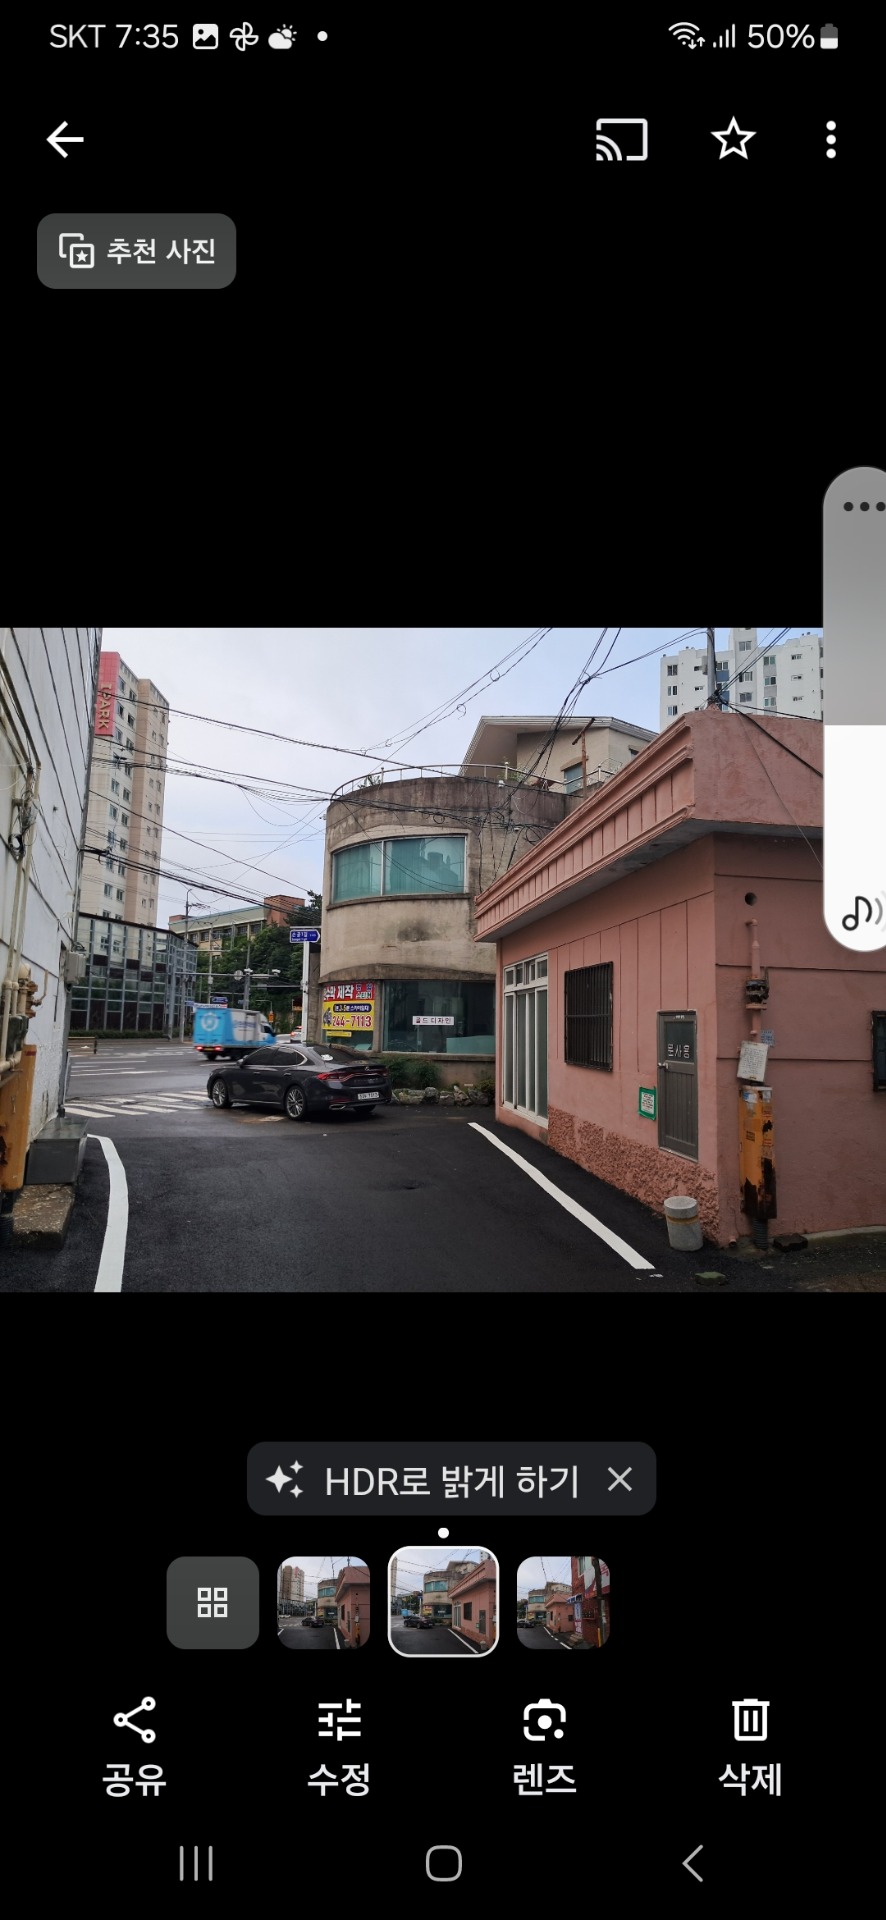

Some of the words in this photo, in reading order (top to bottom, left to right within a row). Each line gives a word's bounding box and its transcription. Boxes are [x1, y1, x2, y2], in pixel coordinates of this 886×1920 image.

[49, 23, 107, 49] SKT
[115, 23, 179, 49] 7:35
[747, 23, 815, 49] 50%
[106, 238, 156, 265] 추천
[165, 238, 215, 265] 사진
[337, 984, 354, 1000] 제작
[332, 1015, 372, 1027] 244-7113
[326, 1466, 431, 1497] HDR로
[442, 1465, 504, 1499] 밝게
[516, 1465, 578, 1499] 하기
[102, 1763, 167, 1798] 공유
[307, 1762, 370, 1797] 수정
[513, 1762, 577, 1796] 렌즈
[718, 1762, 781, 1797] 삭제
